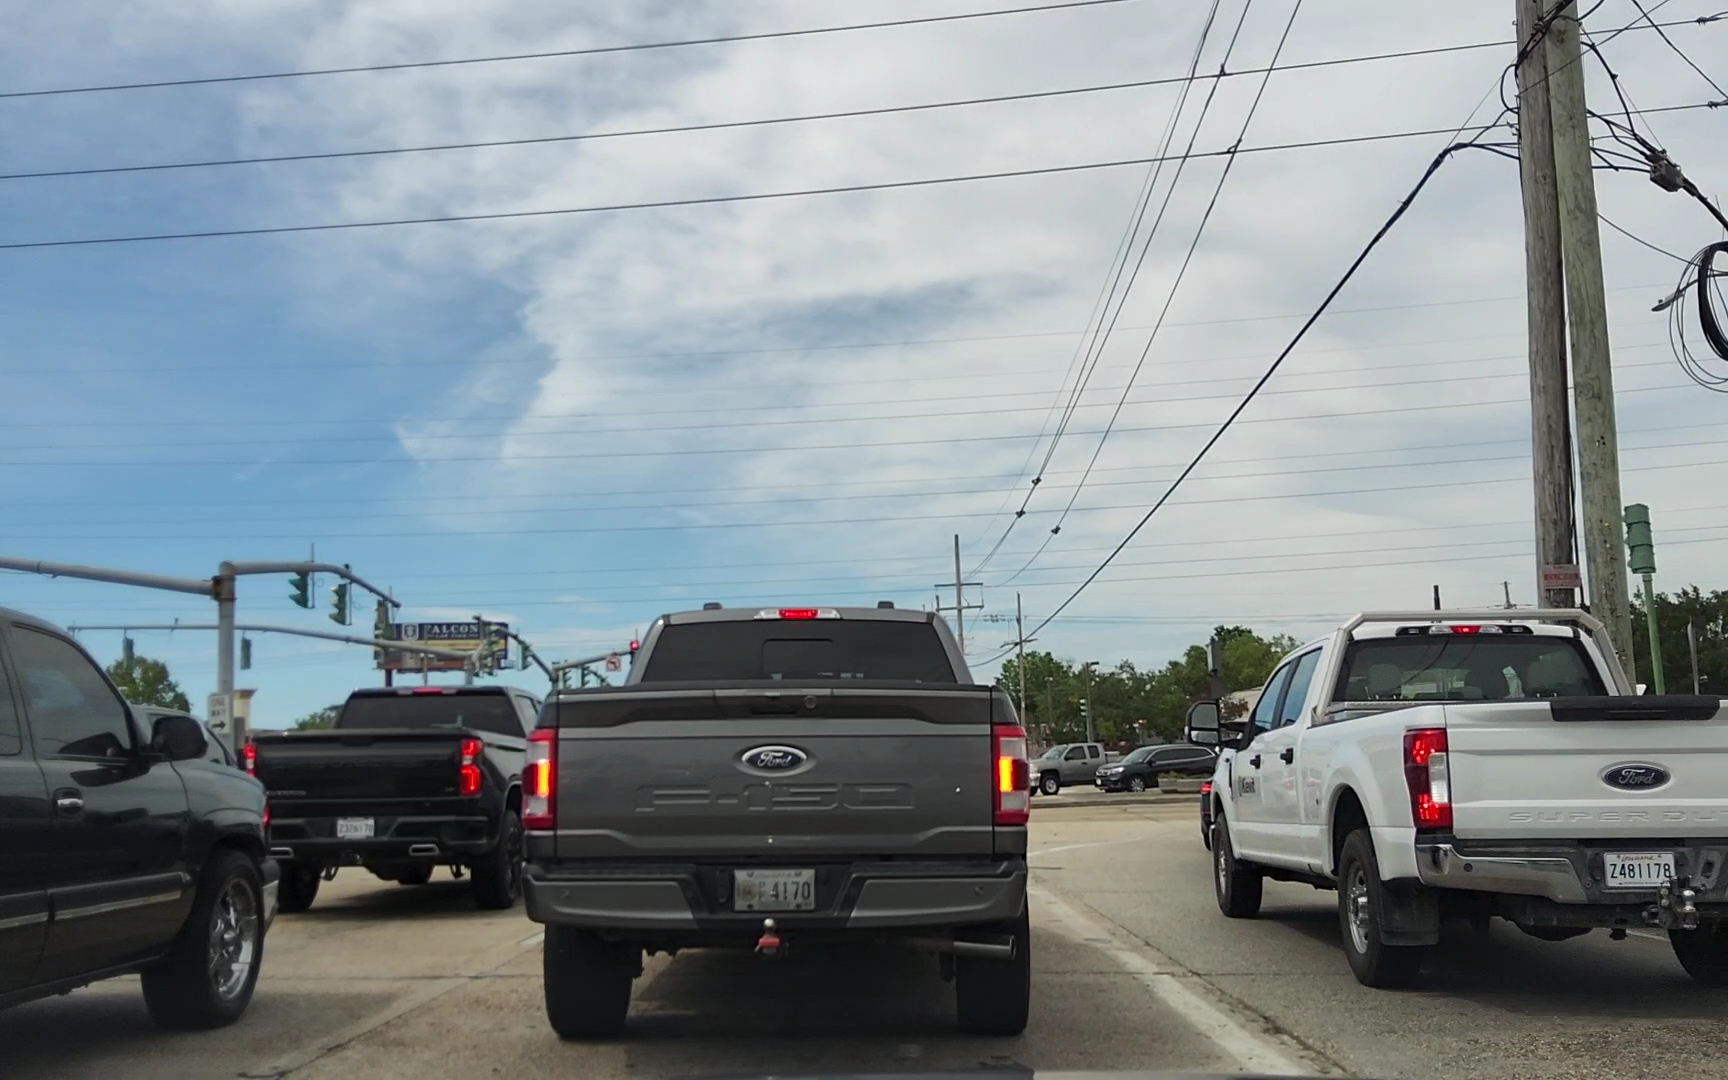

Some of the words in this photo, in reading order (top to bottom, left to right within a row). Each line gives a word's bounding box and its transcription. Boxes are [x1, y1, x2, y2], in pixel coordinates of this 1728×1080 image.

[757, 751, 792, 768] Ford
[1618, 768, 1656, 785] Ford
[634, 783, 914, 812] F-150
[1508, 811, 1651, 823] SUPER
[1609, 863, 1671, 879] Z481178
